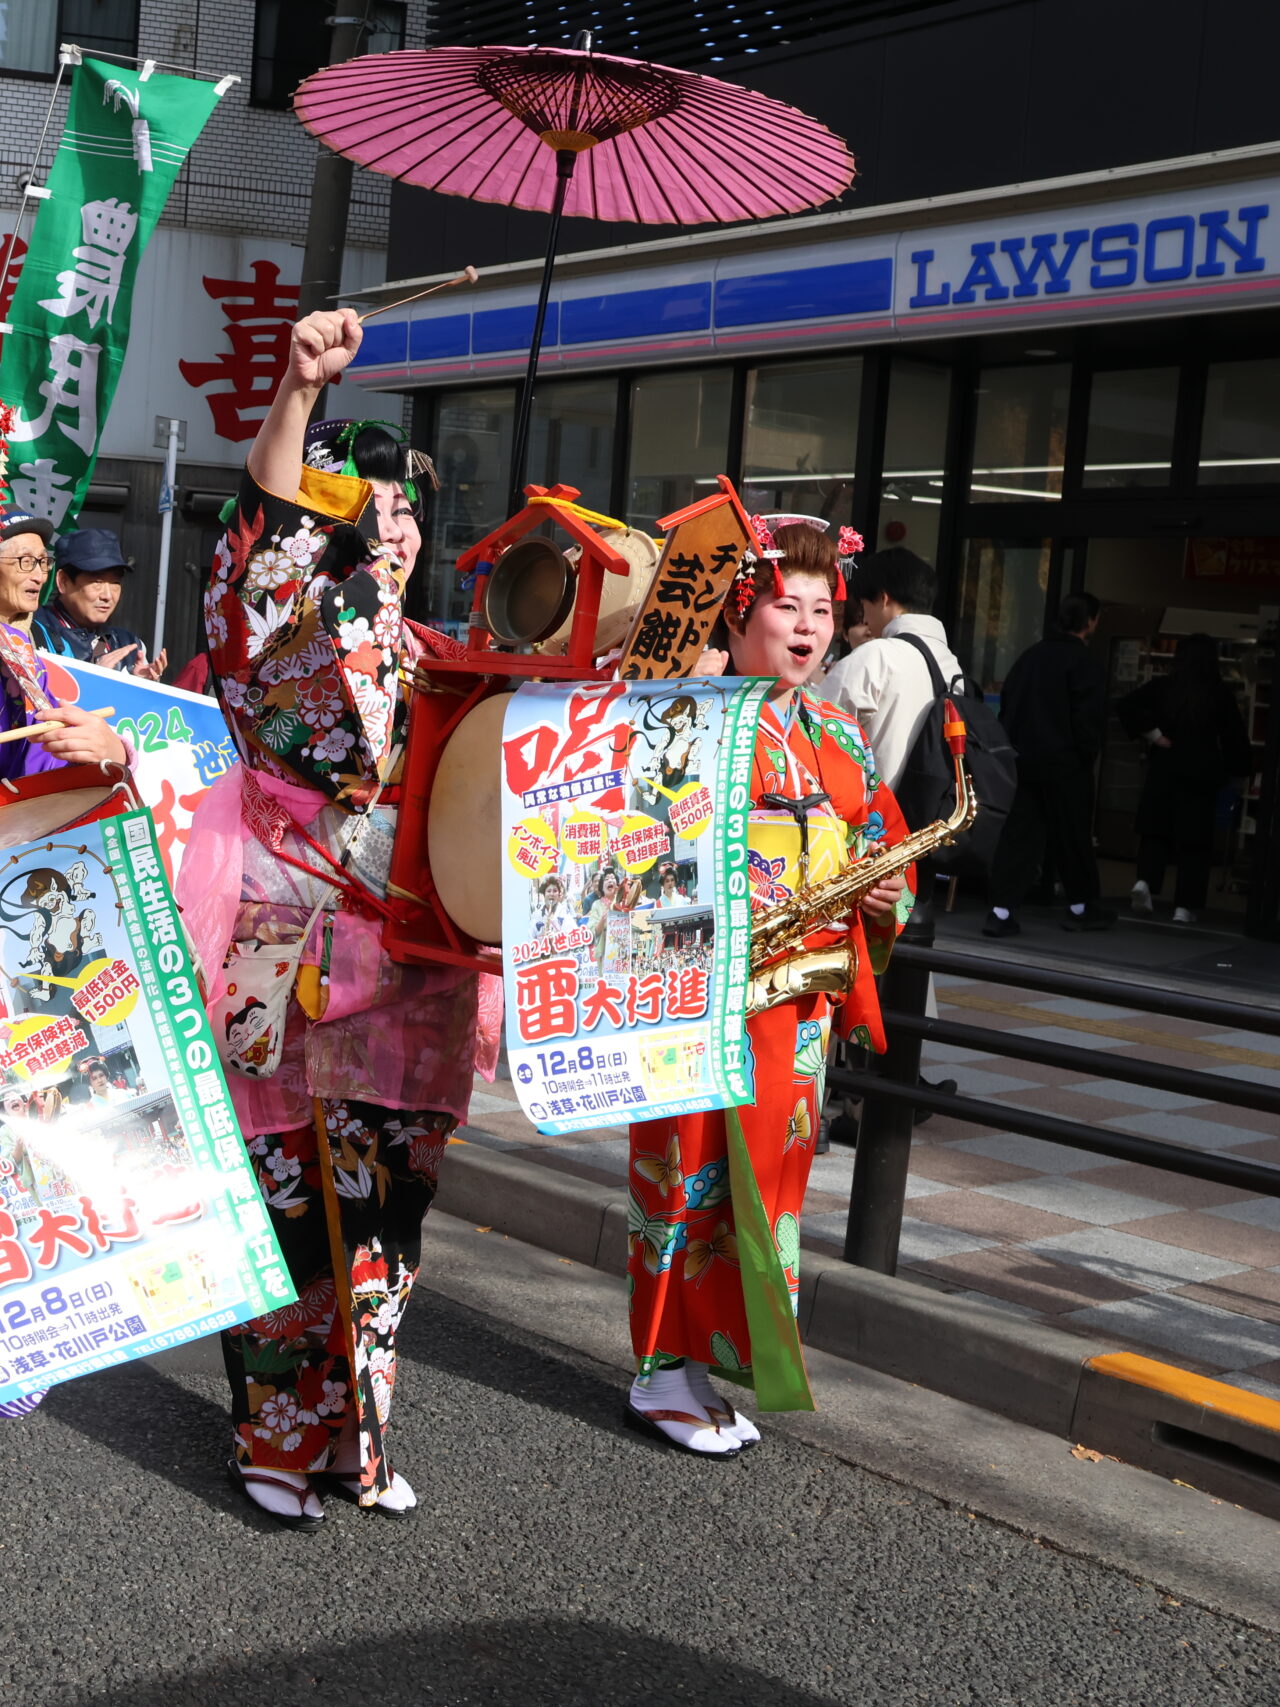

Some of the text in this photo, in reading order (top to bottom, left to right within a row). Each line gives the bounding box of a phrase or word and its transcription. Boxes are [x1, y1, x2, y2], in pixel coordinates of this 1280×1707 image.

[909, 204, 1270, 309] LAWSON
[117, 707, 194, 753] 024
[669, 786, 711, 821] 最低賃金
[673, 801, 714, 834] 1500円
[511, 825, 560, 861] インボイス
[565, 823, 601, 840] 消費税
[578, 840, 601, 856] 減税
[609, 822, 665, 854] 社会保険料
[516, 848, 540, 872] 廃止
[625, 838, 670, 865] 負担軽減
[512, 925, 594, 963] 2024 世直し
[72, 960, 131, 1010] 最低賃金
[84, 974, 141, 1023] 1500円
[516, 960, 708, 1042] 雷大行進
[25, 1031, 89, 1075] 負担軽減
[537, 1045, 628, 1077] 12月8日(日)
[546, 1084, 648, 1117] 浅草・花川戸公園
[8, 1315, 147, 1376] 浅草・花川戸公園
